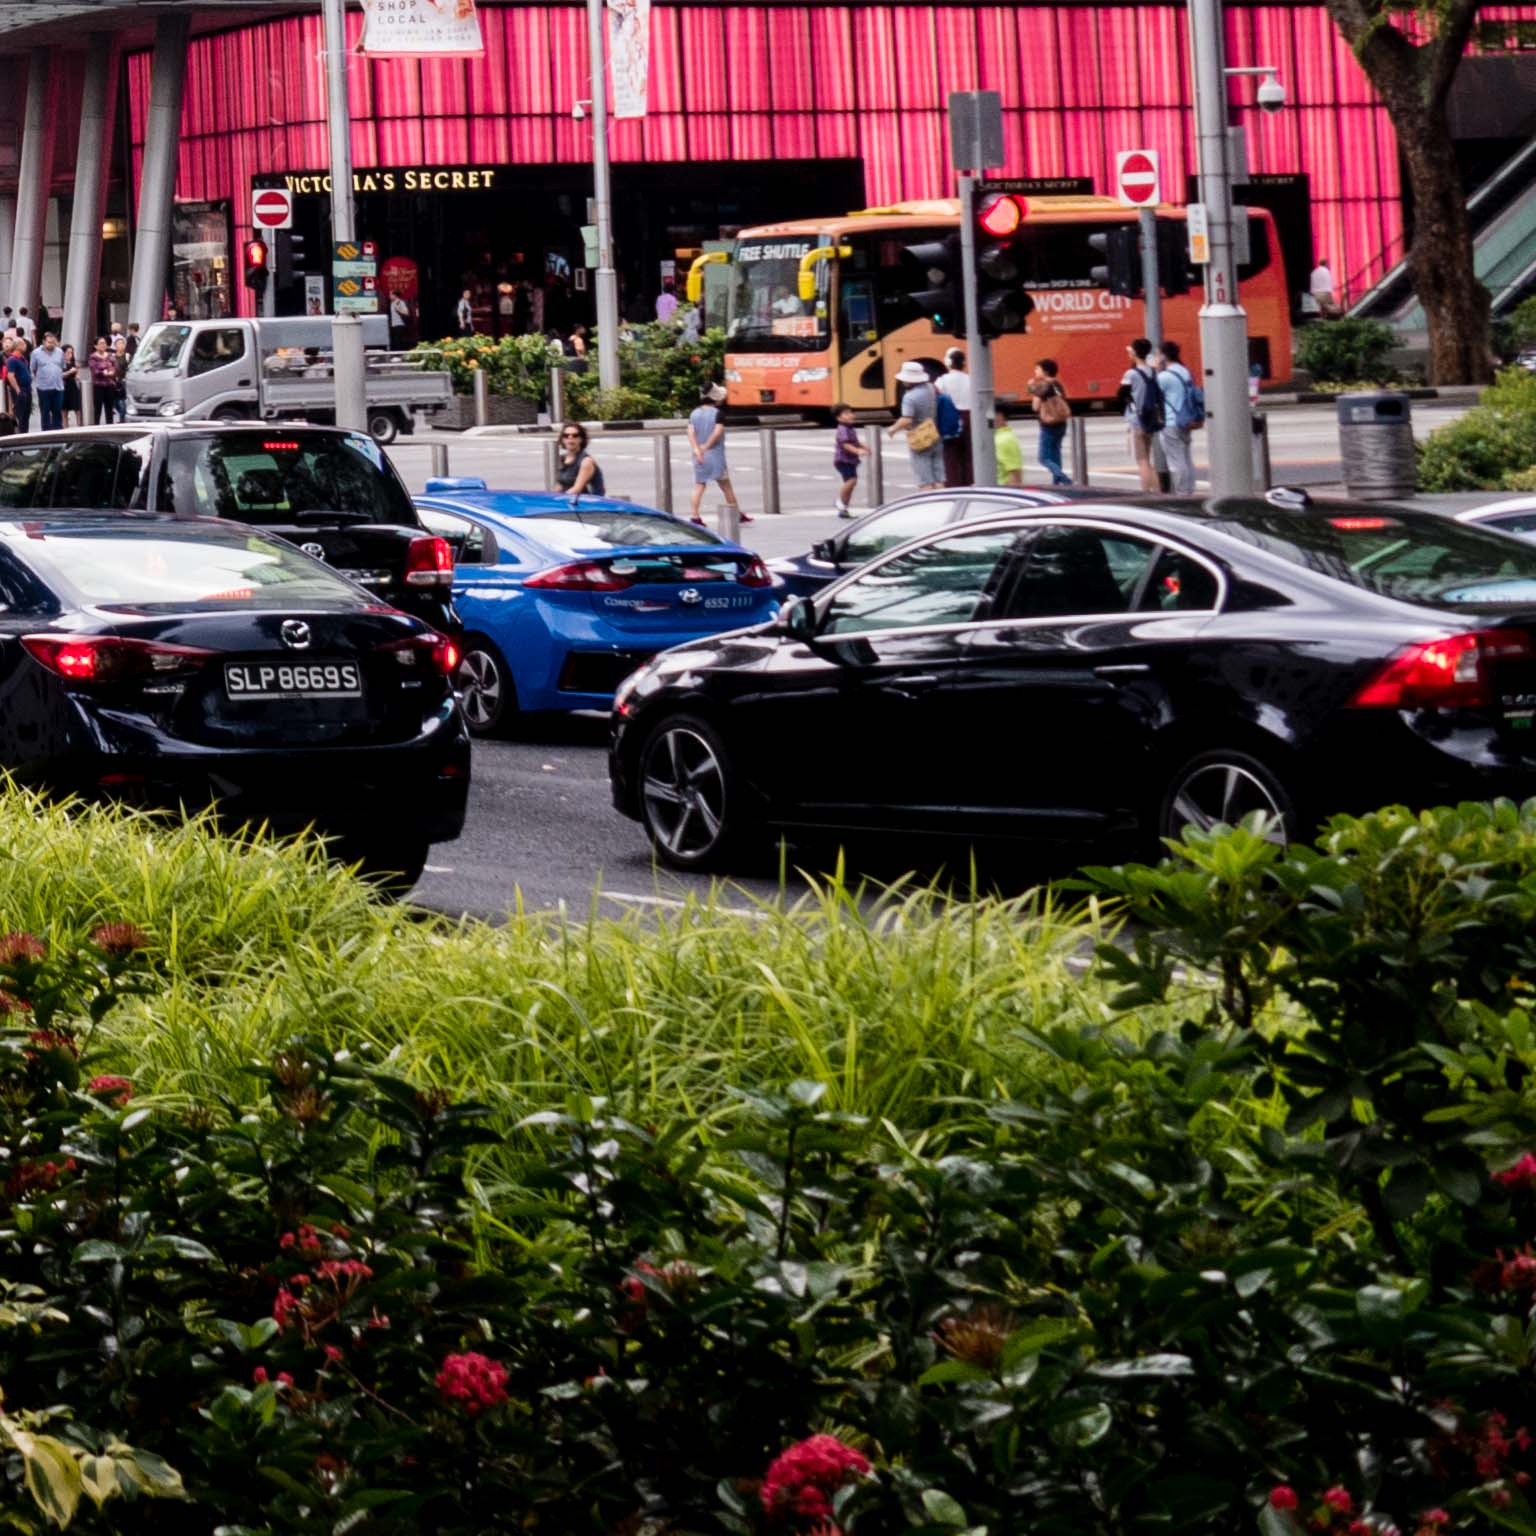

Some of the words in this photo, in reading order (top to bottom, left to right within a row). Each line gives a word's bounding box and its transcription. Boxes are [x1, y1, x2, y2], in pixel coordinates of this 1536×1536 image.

[377, 0, 416, 11] SHOP
[377, 15, 427, 24] LOCAL
[285, 172, 394, 193] VICTOIA'S
[404, 170, 495, 191] SECRET
[738, 246, 763, 262] FREE
[762, 243, 810, 260] SHUTTLE
[1032, 293, 1094, 312] WORLD
[704, 597, 730, 609] 6552
[731, 595, 753, 607] 1111
